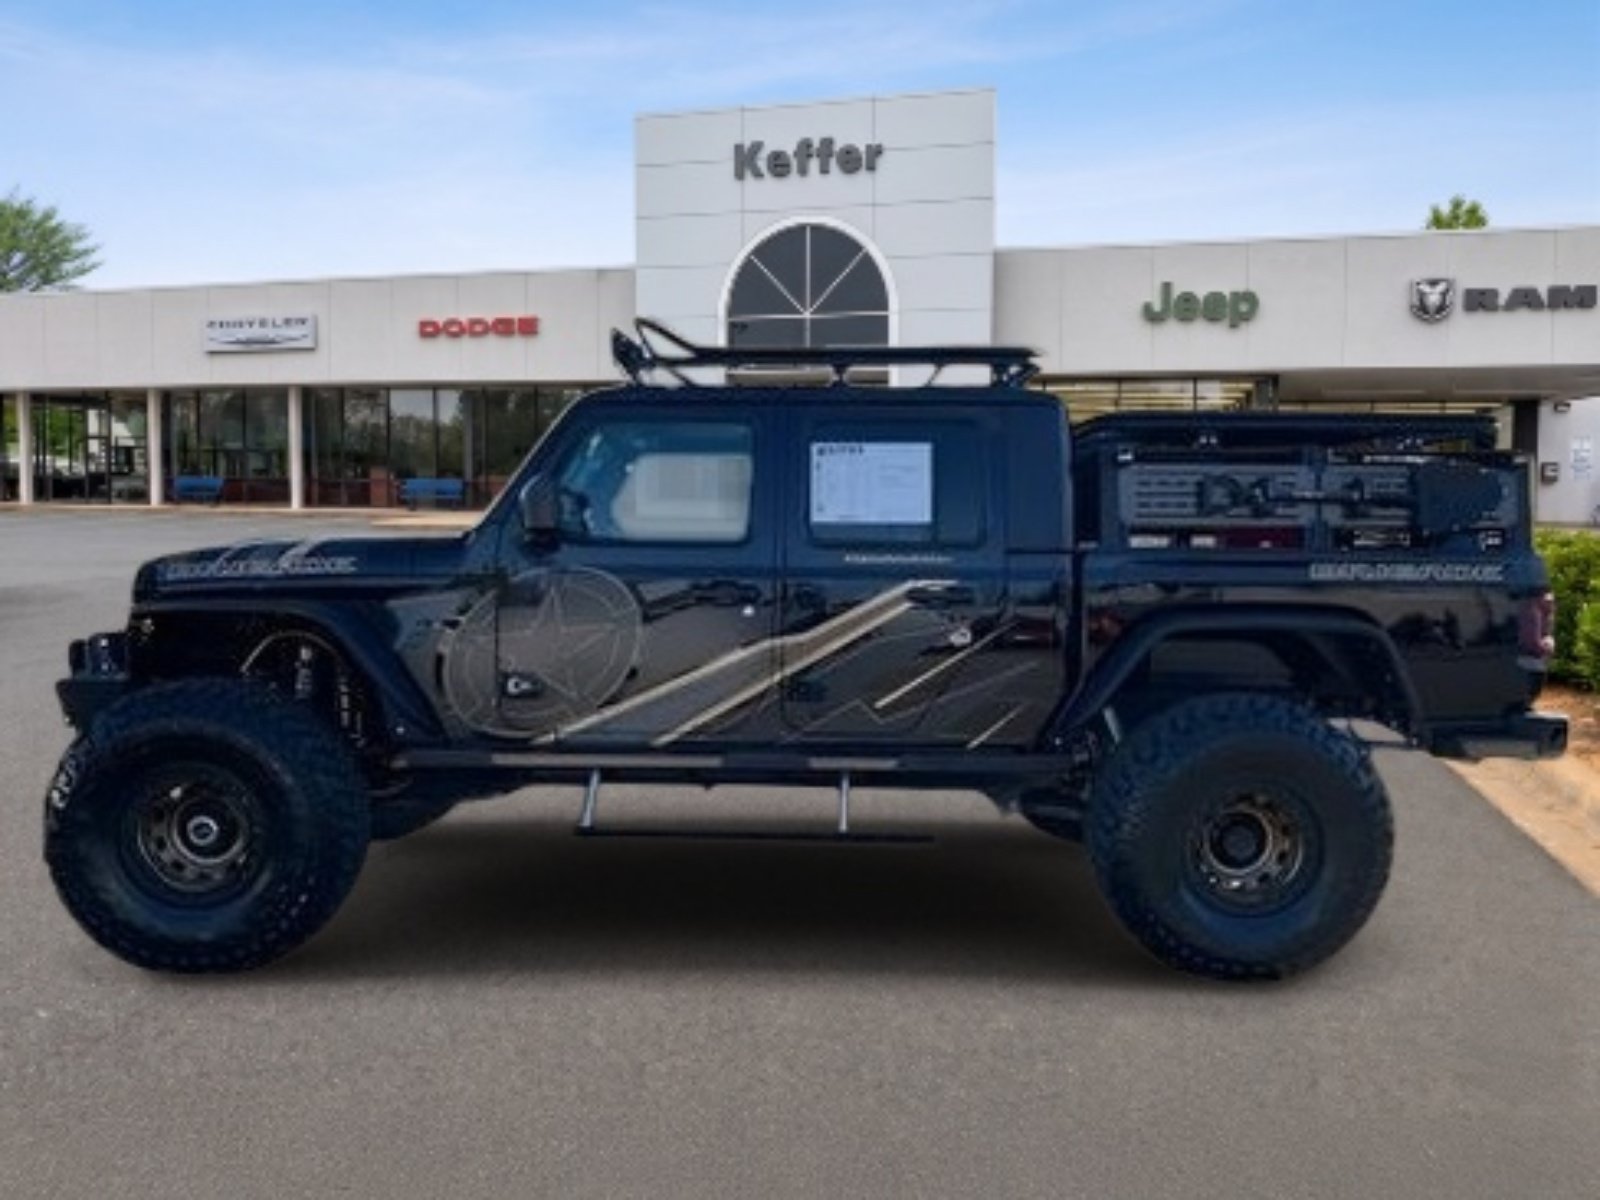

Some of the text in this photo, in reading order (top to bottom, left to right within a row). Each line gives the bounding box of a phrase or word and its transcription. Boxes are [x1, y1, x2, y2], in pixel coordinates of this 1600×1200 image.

[733, 137, 883, 180] Keffer
[1141, 281, 1260, 328] Jeep
[1463, 284, 1598, 312] RAM
[419, 316, 540, 338] DODGE
